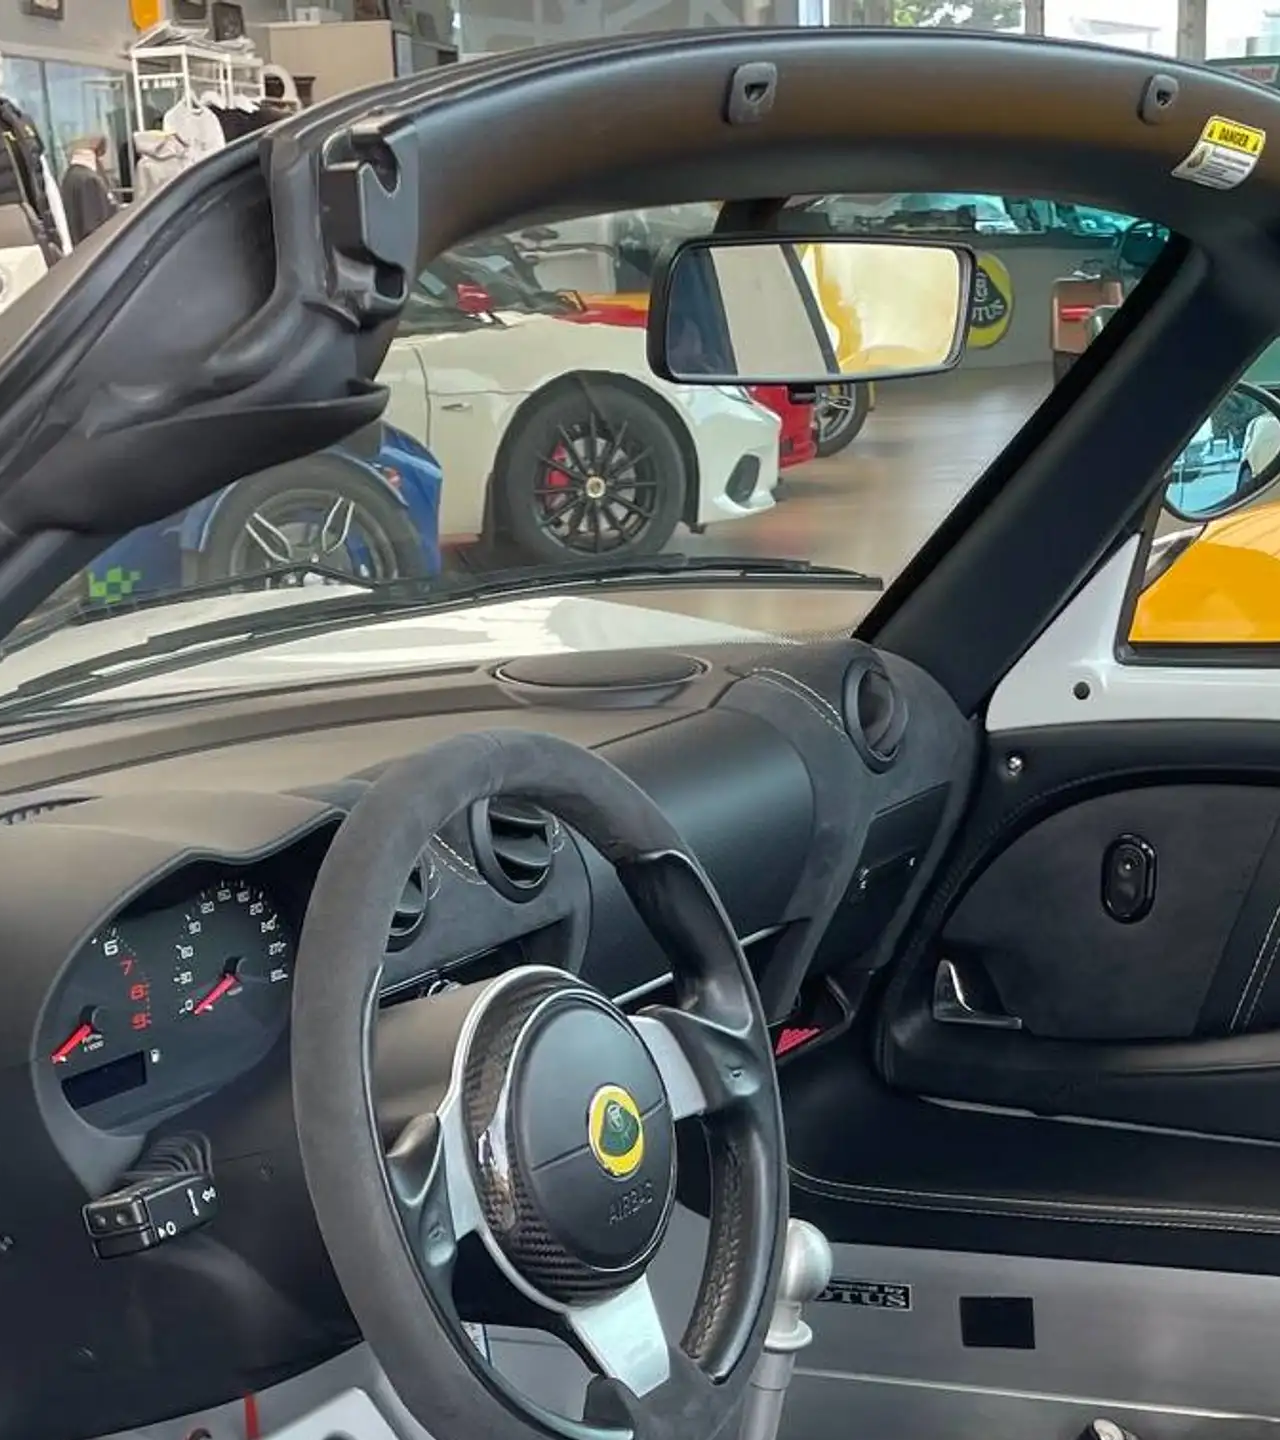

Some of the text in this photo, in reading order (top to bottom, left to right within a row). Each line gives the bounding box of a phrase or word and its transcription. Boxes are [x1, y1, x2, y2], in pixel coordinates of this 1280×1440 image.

[1218, 127, 1249, 147] DANGER
[103, 939, 119, 957] 6
[120, 958, 133, 976] 7
[184, 999, 194, 1011] 0
[131, 1012, 147, 1030] 9
